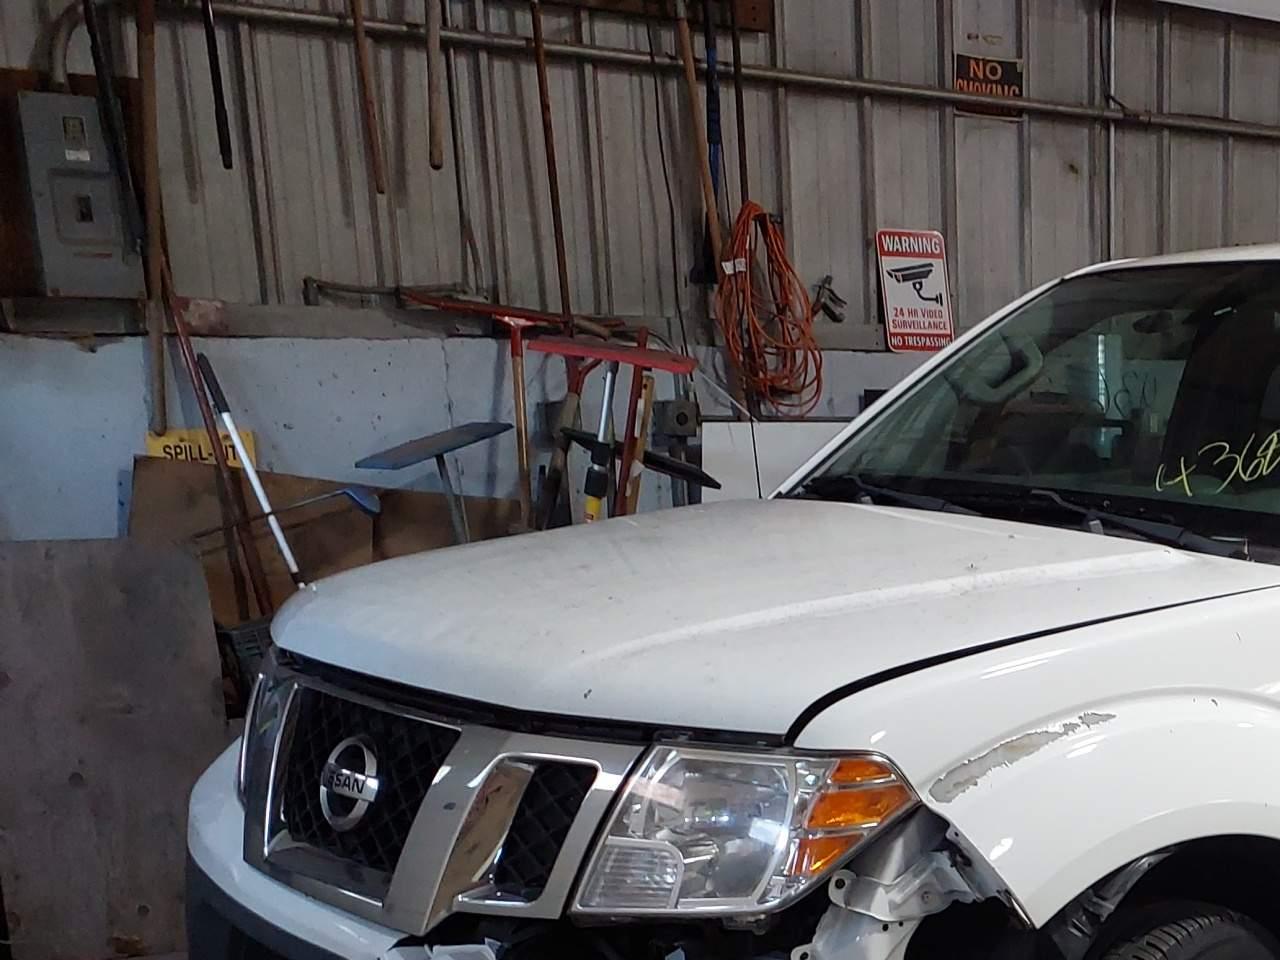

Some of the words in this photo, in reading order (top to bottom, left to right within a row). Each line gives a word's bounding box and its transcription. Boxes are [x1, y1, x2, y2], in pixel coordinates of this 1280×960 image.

[969, 59, 1002, 80] NO
[881, 235, 940, 254] WARNING
[893, 307, 904, 318] 24
[907, 308, 918, 318] HR
[921, 308, 943, 319] VIDEO
[892, 319, 947, 330] SURVEILLANCE
[891, 335, 903, 346] NO
